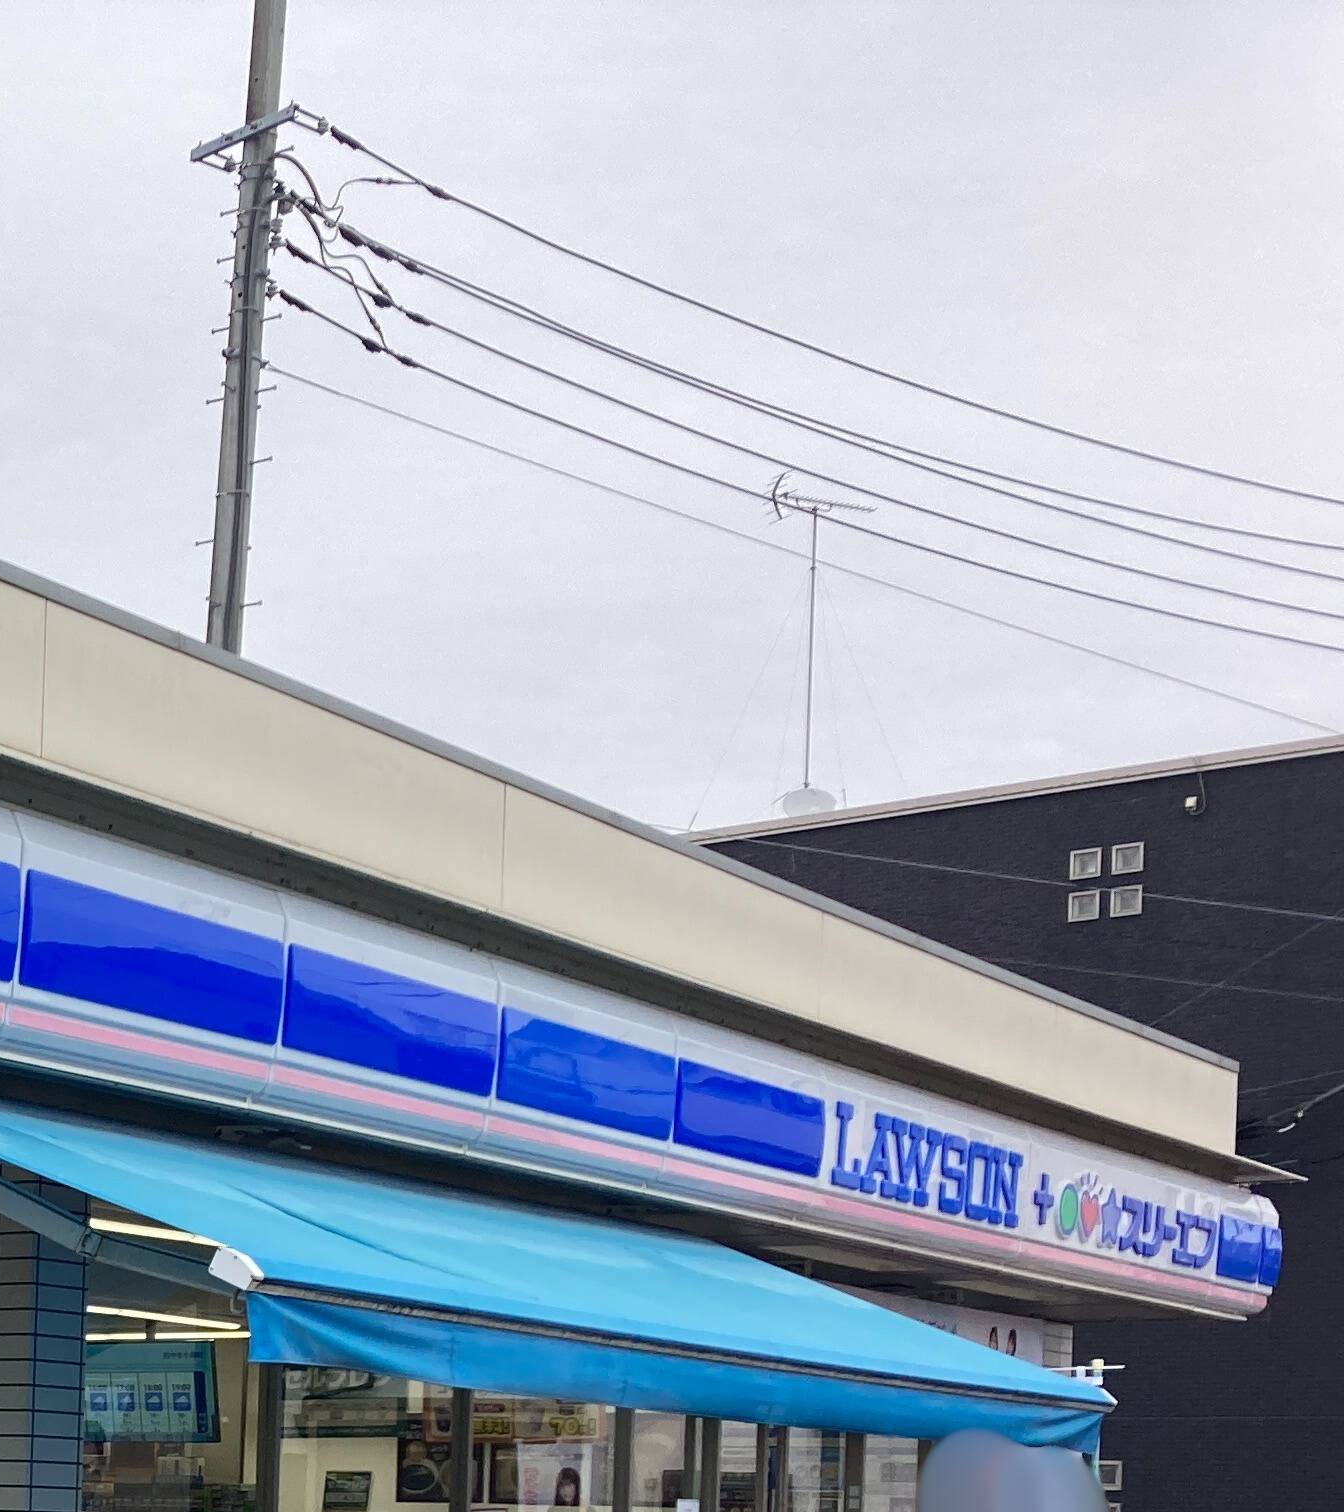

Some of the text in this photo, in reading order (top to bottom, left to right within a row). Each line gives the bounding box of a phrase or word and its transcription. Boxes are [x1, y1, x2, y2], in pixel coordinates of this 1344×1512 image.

[831, 1101, 1217, 1268] LAWSON + スリーエフ
